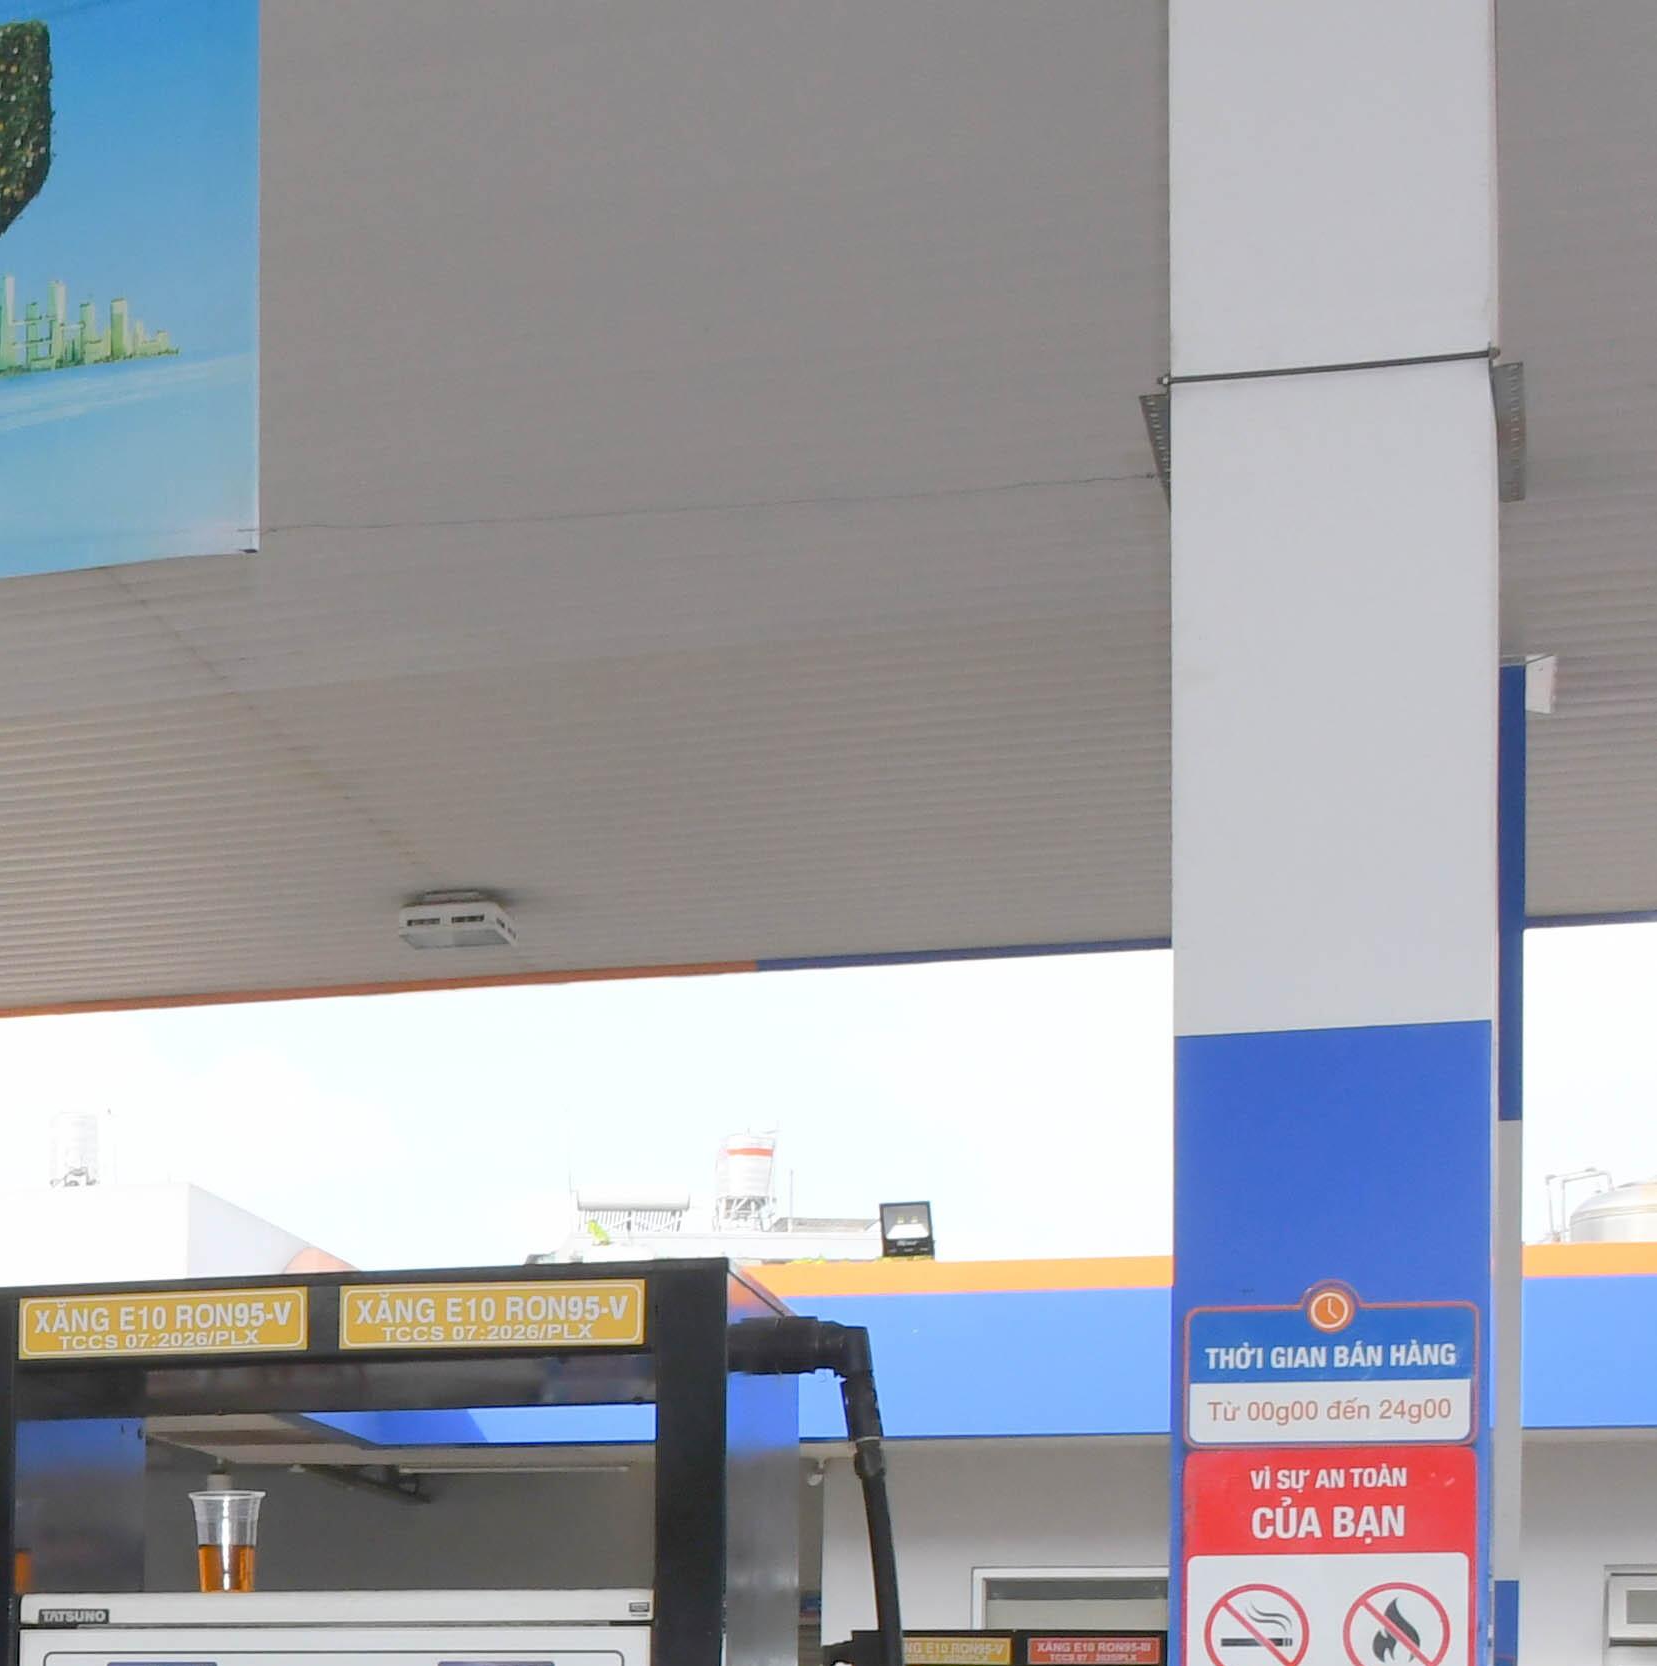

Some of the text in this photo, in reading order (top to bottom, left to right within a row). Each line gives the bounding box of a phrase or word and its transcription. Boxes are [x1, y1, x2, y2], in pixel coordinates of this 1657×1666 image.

[34, 1301, 293, 1334] XĂNG E10 RON95-V
[355, 1294, 628, 1325] XĂNG E10 RON95-V
[58, 1330, 260, 1349] TCCS 07:2026/PLX
[381, 1324, 593, 1342] TCCS 07:2026/PLX
[1205, 1339, 1456, 1370] THỜI GIAN BÁN HÀNG
[1207, 1397, 1452, 1426] Từ 00g00 đến 24g00
[1250, 1463, 1408, 1493] VÌ SỰ AN TOÀN
[1251, 1496, 1405, 1544] CỦA BẠN
[41, 1610, 107, 1623] TATSUNO
